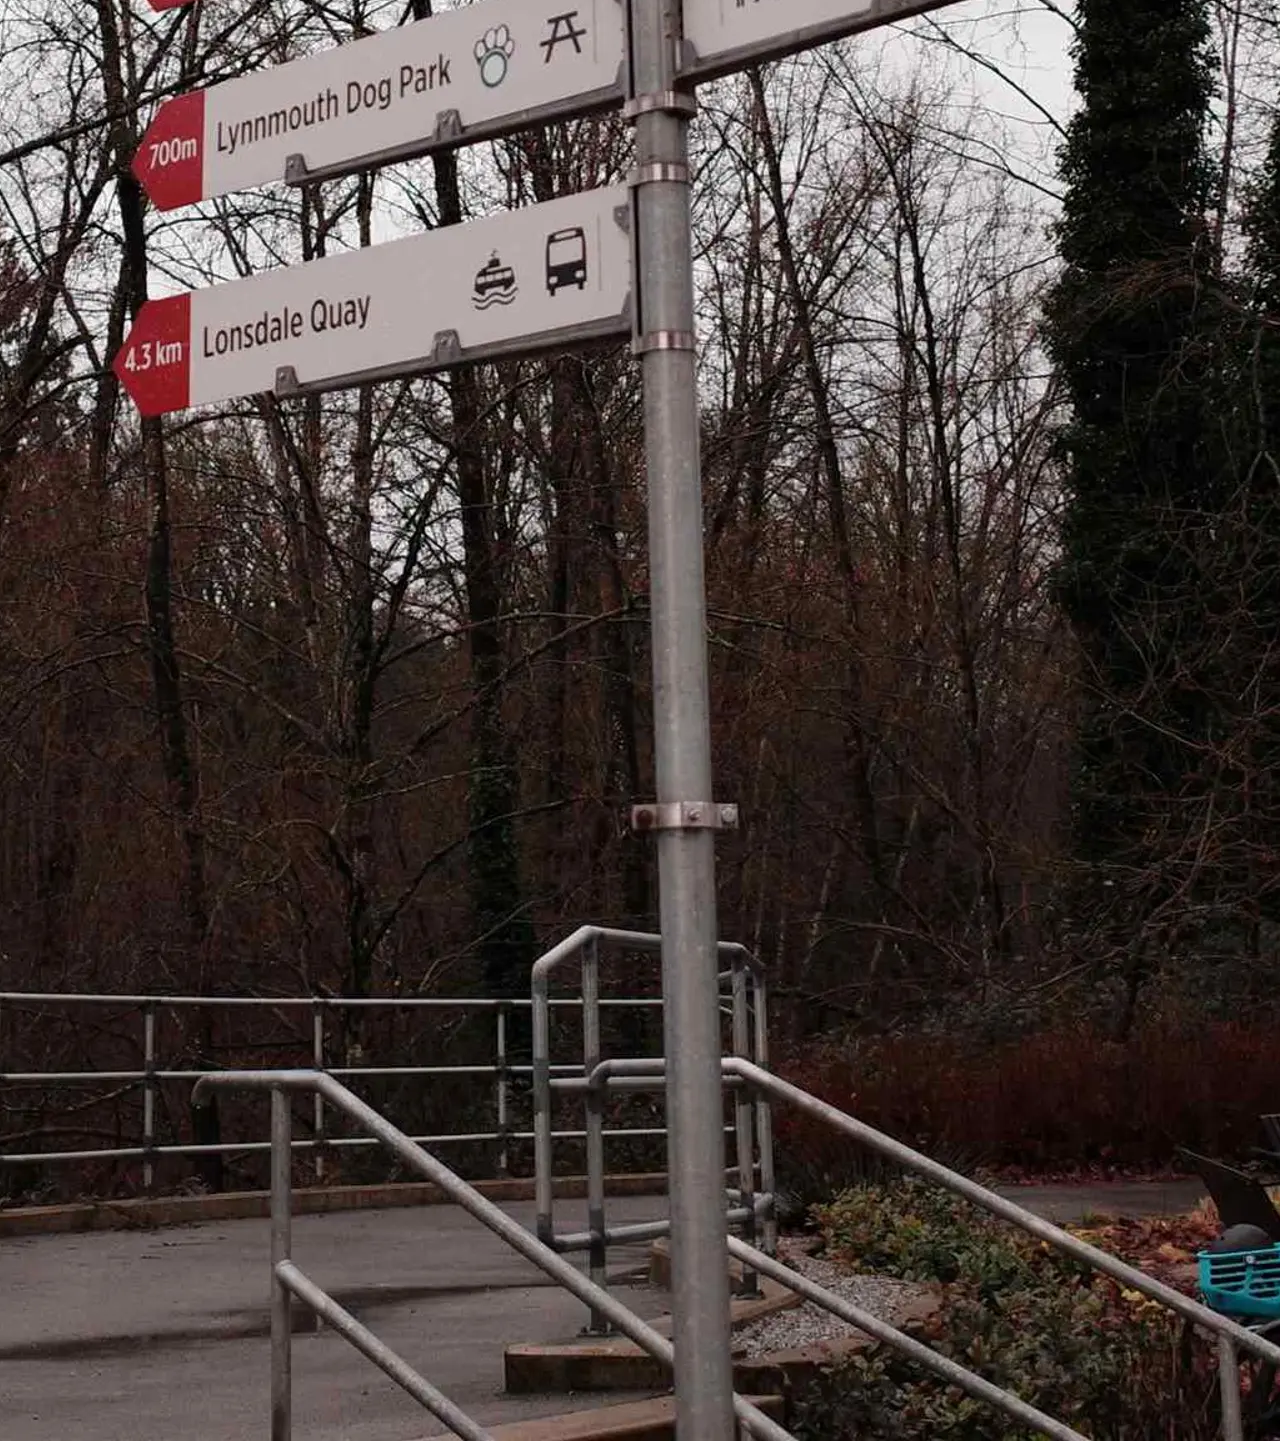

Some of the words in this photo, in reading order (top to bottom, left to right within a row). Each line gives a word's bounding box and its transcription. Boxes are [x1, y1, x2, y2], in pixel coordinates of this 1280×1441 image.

[217, 88, 339, 155] Lynnmouth
[346, 78, 392, 114] Dog
[400, 54, 452, 98] Park
[149, 137, 197, 170] 700m
[203, 307, 303, 358] Lonsdale
[310, 296, 371, 333] Quay
[124, 342, 152, 372] 4.3
[155, 340, 182, 367] km
